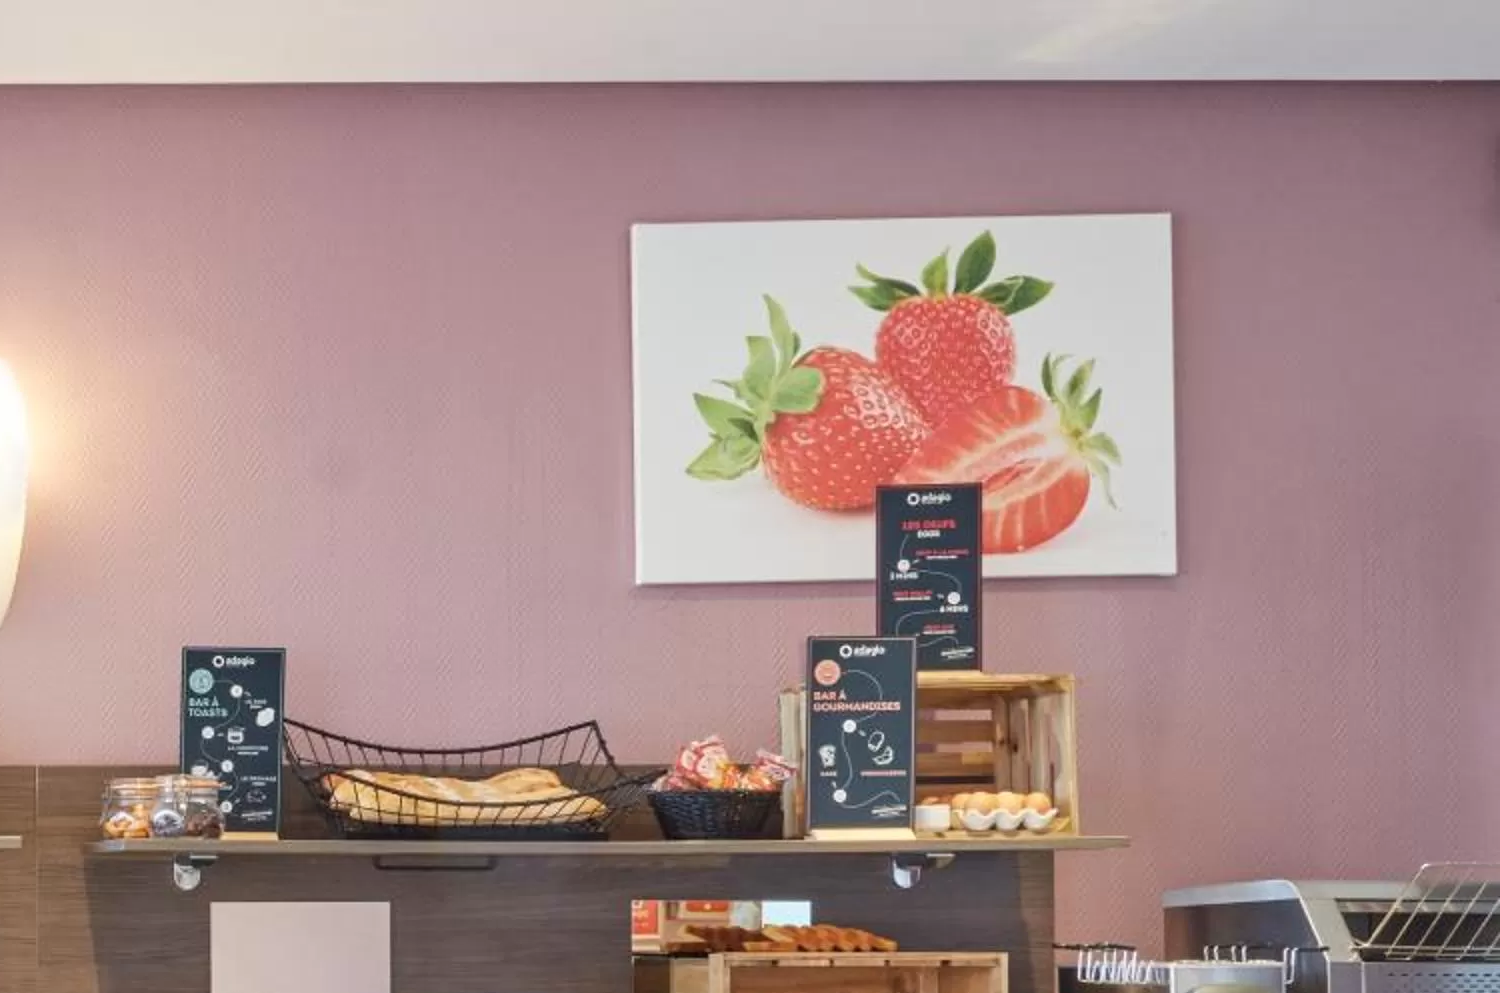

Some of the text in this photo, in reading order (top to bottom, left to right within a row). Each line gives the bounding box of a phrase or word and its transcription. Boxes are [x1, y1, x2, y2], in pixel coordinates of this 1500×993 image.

[814, 691, 837, 700] BAR
[188, 698, 210, 707] BAR
[813, 701, 901, 711] GOURMANDISES
[188, 708, 229, 717] TOASTS
